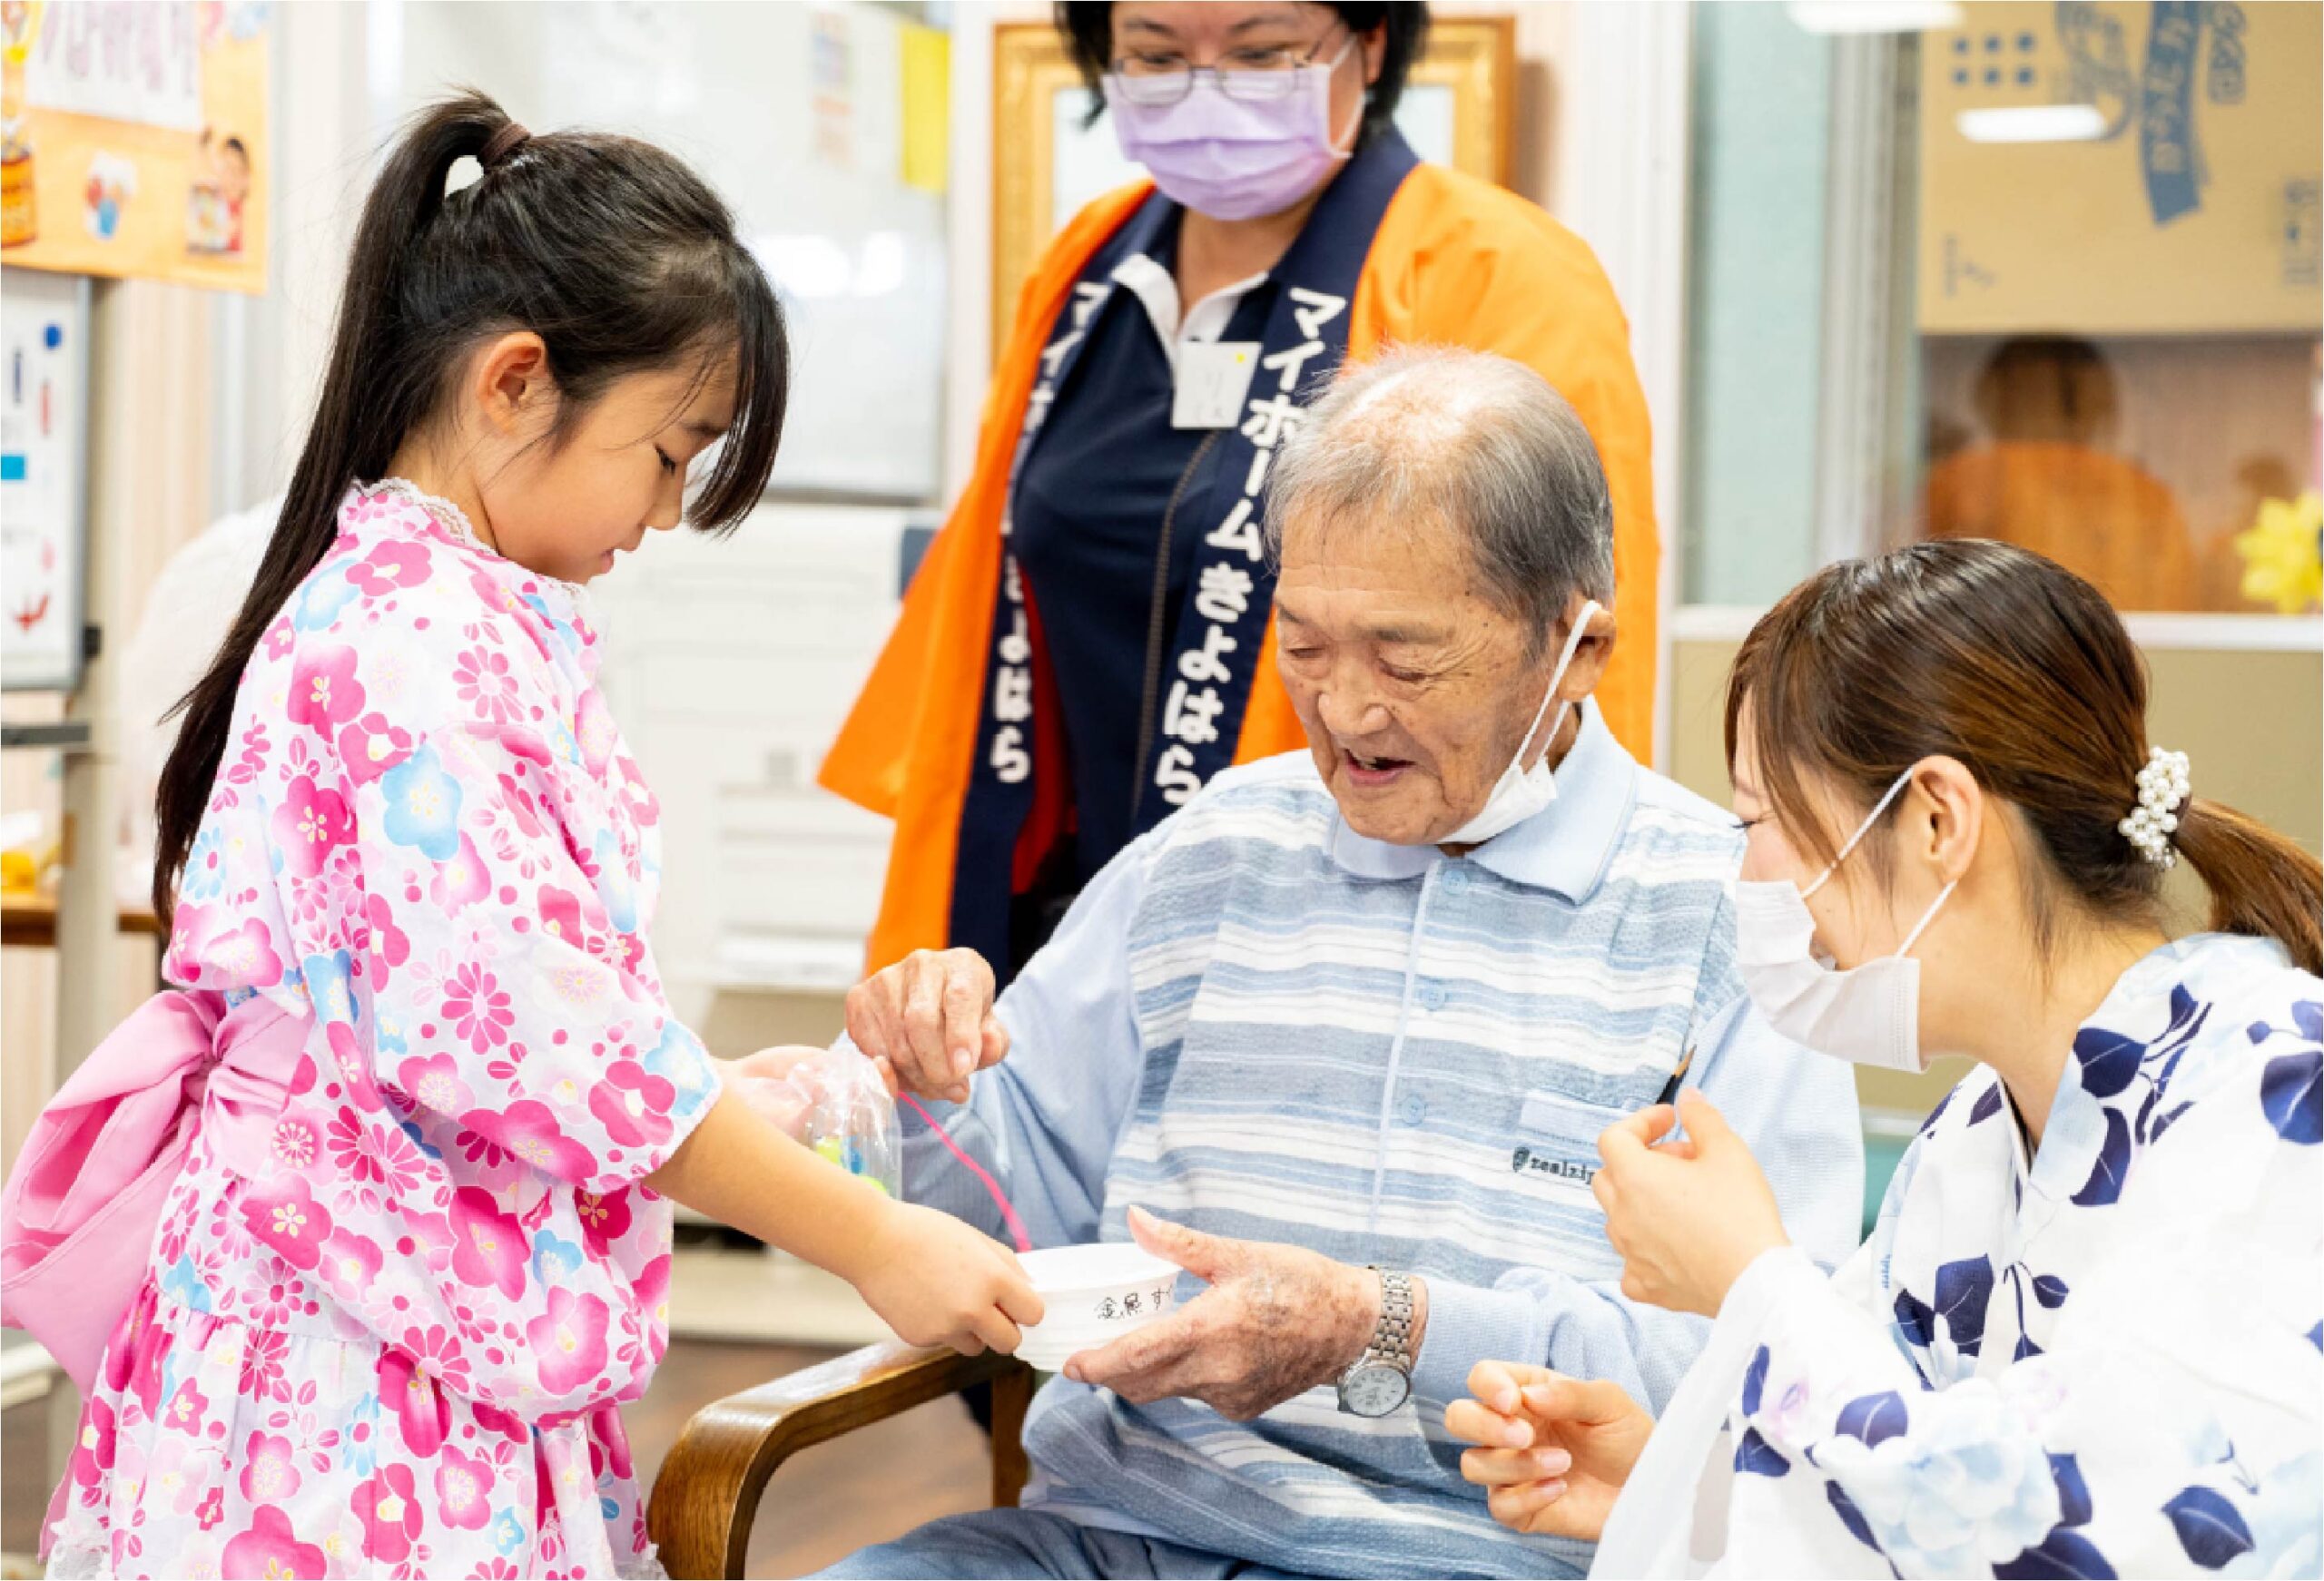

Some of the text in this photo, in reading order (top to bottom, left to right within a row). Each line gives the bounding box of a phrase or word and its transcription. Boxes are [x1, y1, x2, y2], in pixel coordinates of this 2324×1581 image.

[1154, 287, 1347, 805] マイホームきよはら
